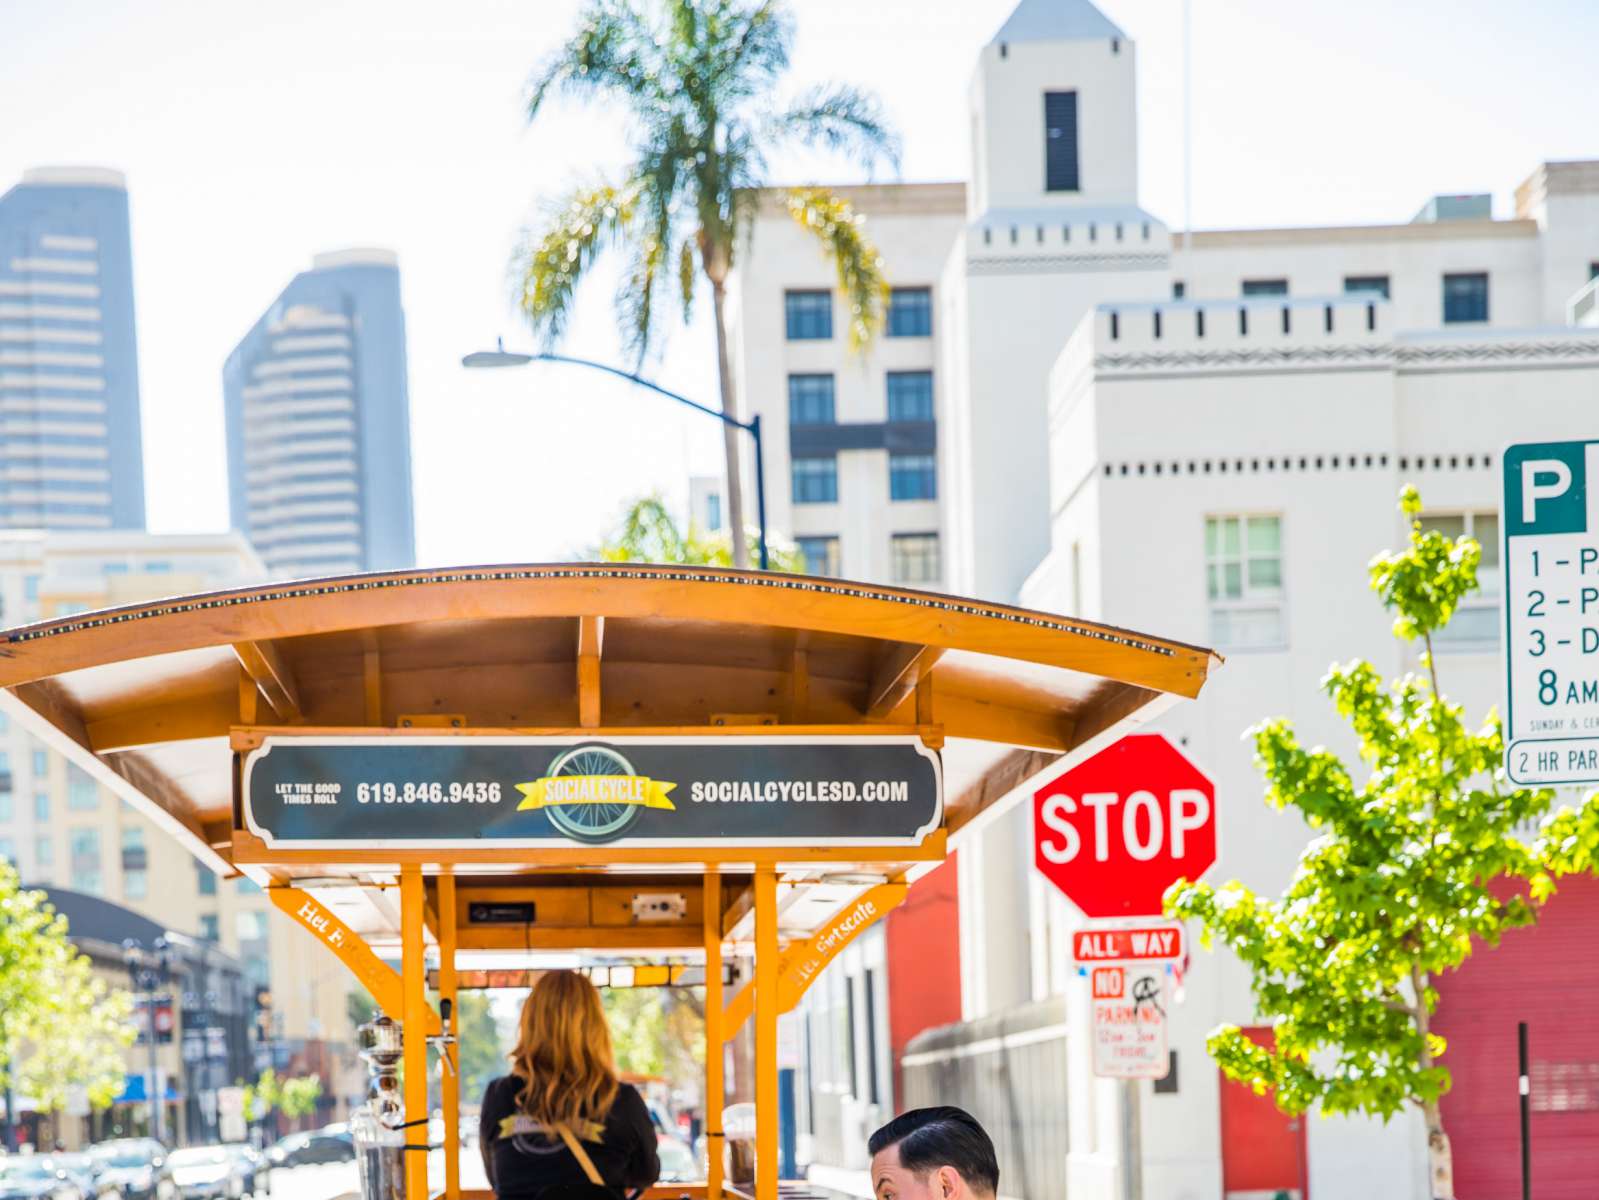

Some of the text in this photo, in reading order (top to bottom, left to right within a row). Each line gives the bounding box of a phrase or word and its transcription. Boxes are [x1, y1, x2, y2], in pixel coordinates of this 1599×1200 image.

[1521, 459, 1573, 524] P
[1531, 550, 1539, 577] 1
[1580, 547, 1599, 576] P
[1527, 590, 1546, 617] 2
[1528, 629, 1546, 657] 3
[1530, 719, 1564, 732] SUNDAY
[1519, 752, 1528, 773] 2
[1538, 751, 1559, 772] HR
[275, 783, 341, 794] LET THE GOOD
[282, 794, 338, 805] TIMES ROLL
[356, 782, 502, 804] 619.846.9436
[690, 780, 909, 803] SOCIALCYCLESD.COM
[1040, 789, 1211, 864] STOP
[1078, 931, 1175, 959] ALL WAY
[1094, 969, 1122, 998] NO
